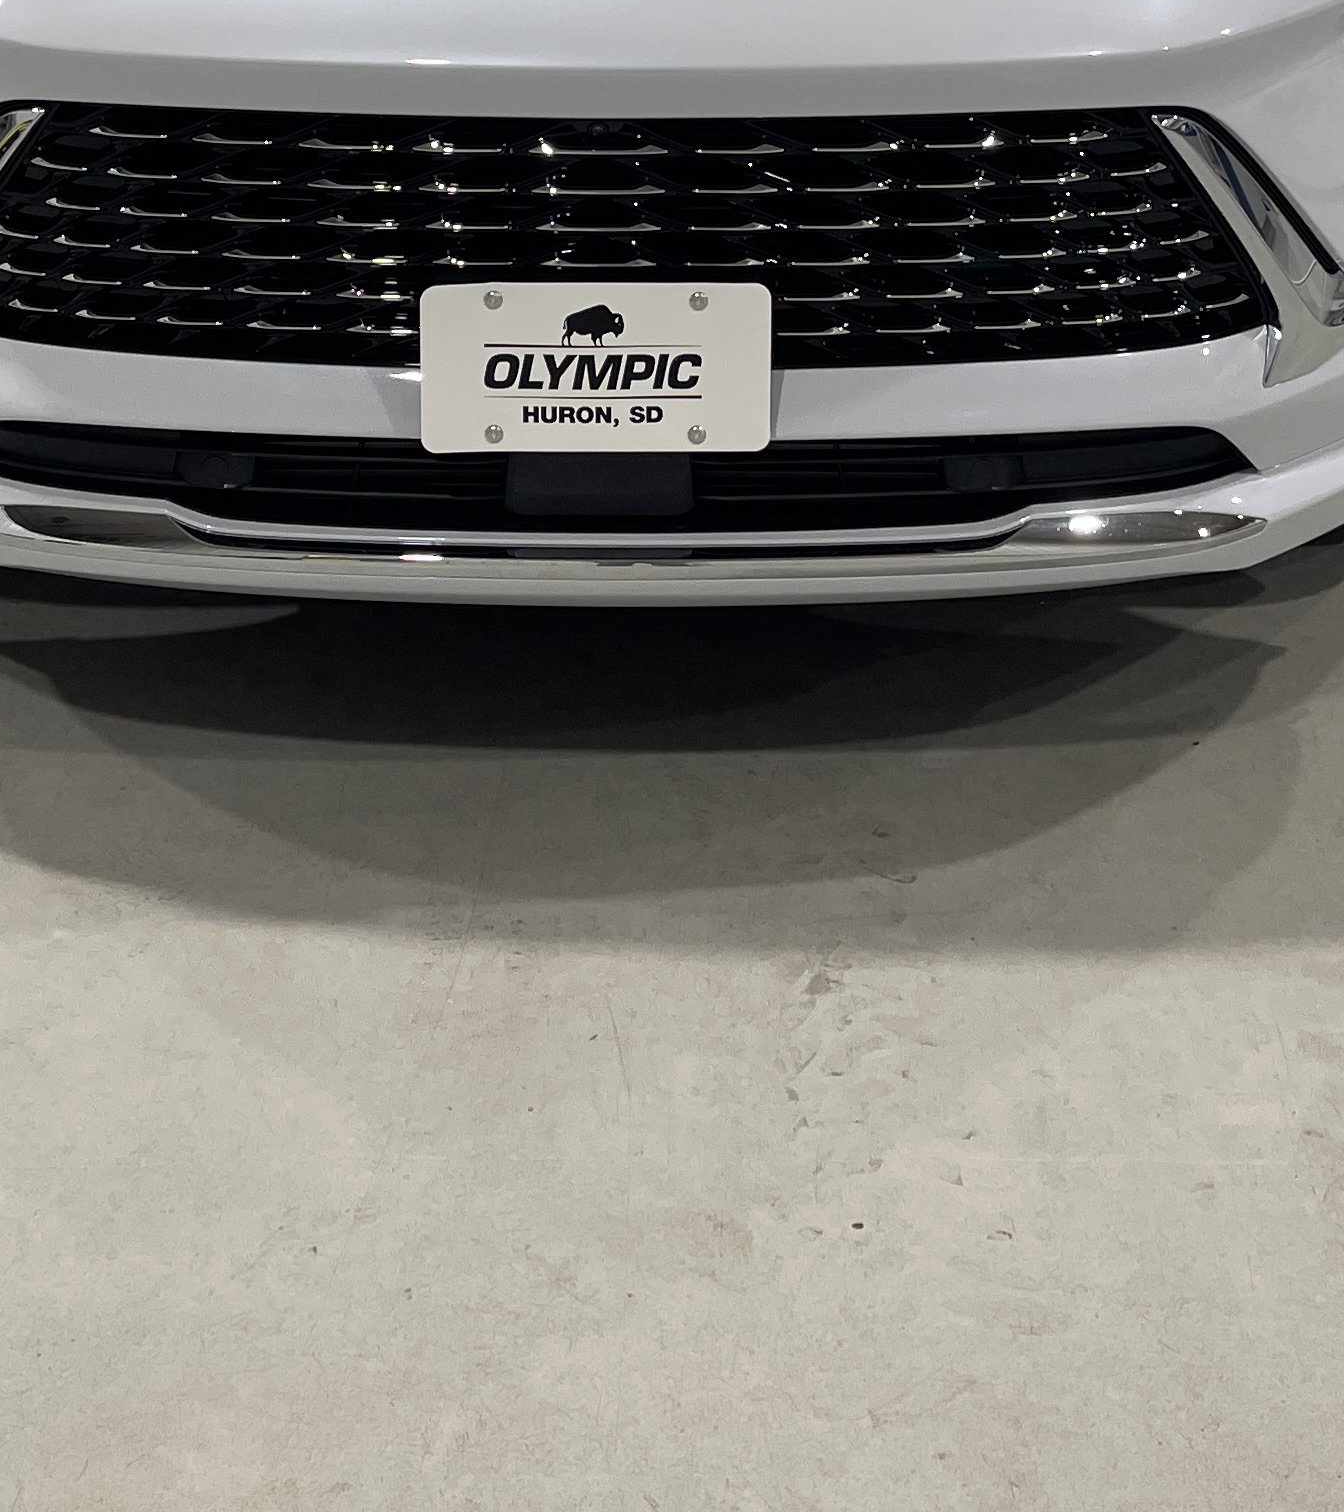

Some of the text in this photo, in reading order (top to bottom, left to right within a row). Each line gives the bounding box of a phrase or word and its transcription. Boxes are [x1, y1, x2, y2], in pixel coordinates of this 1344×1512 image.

[484, 353, 702, 390] OLYMPIC
[522, 405, 664, 428] HURON, SD
